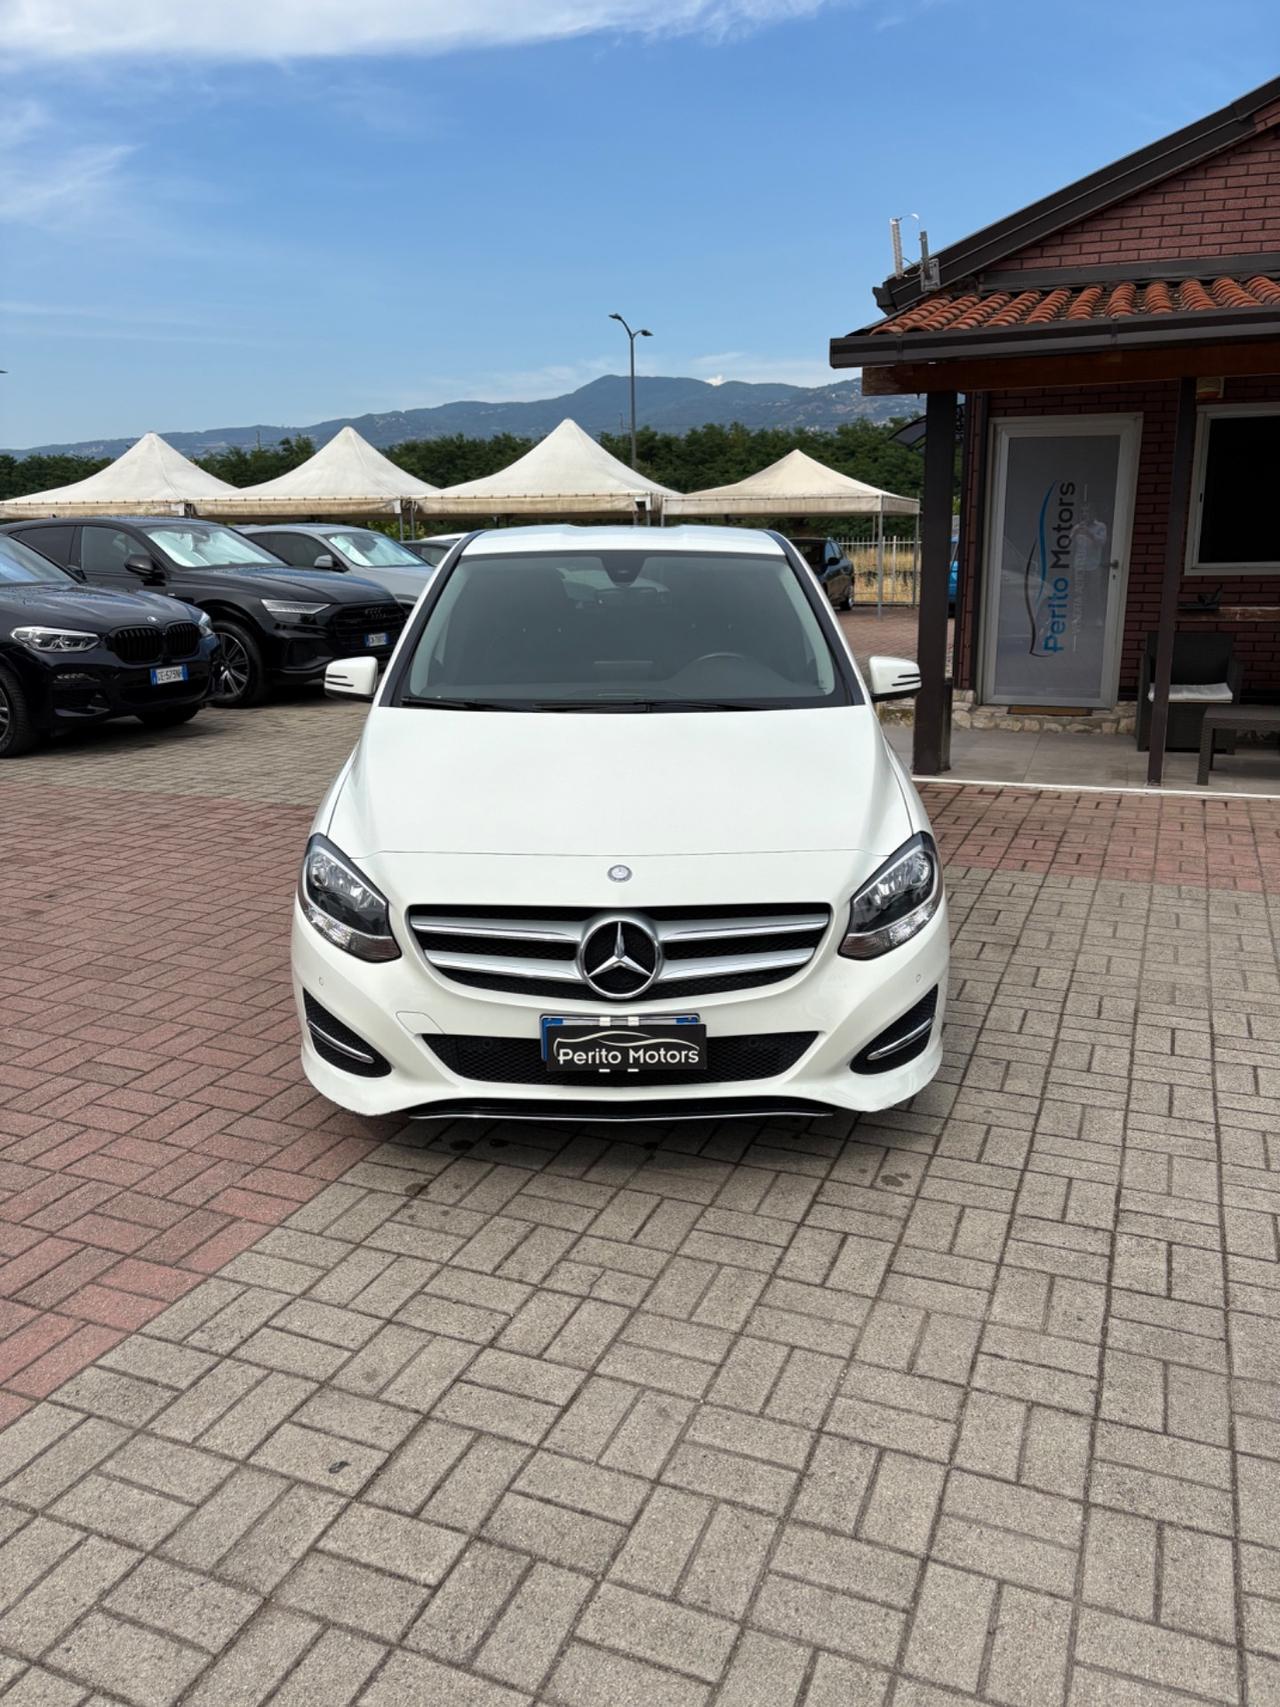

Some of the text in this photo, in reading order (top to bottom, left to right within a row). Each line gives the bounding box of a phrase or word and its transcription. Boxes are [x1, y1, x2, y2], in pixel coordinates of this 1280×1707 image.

[1044, 481, 1076, 653] Perito Motors
[557, 1047, 699, 1065] Perito Motors
